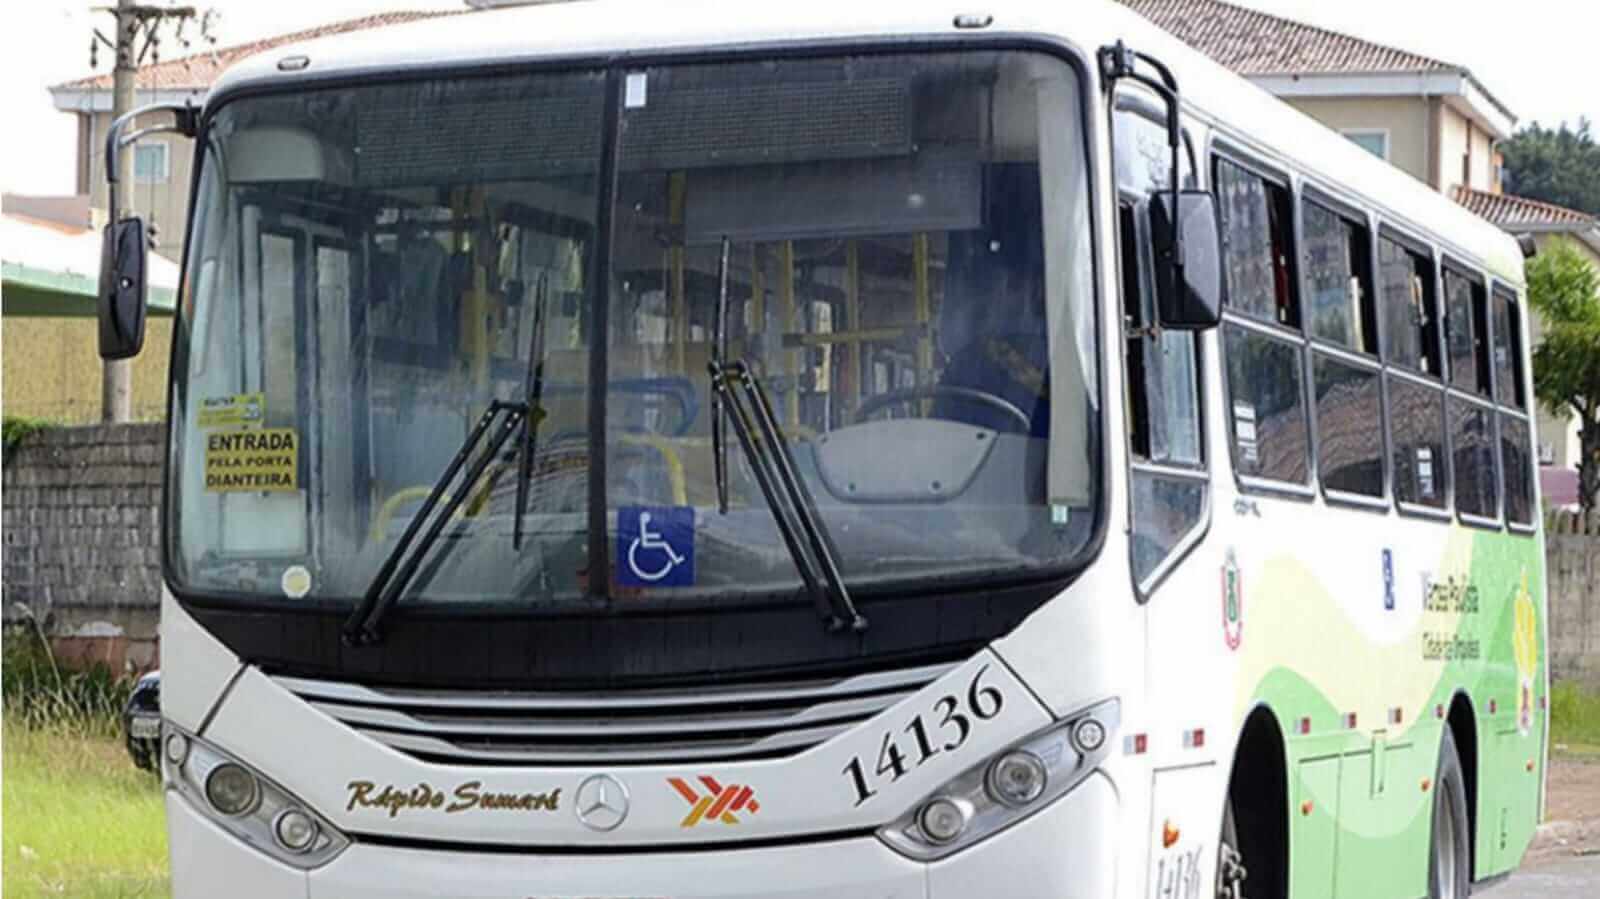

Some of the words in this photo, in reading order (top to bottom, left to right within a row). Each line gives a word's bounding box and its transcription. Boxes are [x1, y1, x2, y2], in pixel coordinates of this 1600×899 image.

[209, 433, 293, 450] ENTRADA
[209, 458, 242, 467] PELA
[248, 457, 292, 466] PORTA
[208, 474, 292, 487] DIANTEIRA
[841, 664, 1004, 807] 14136
[347, 781, 445, 818] Rápido
